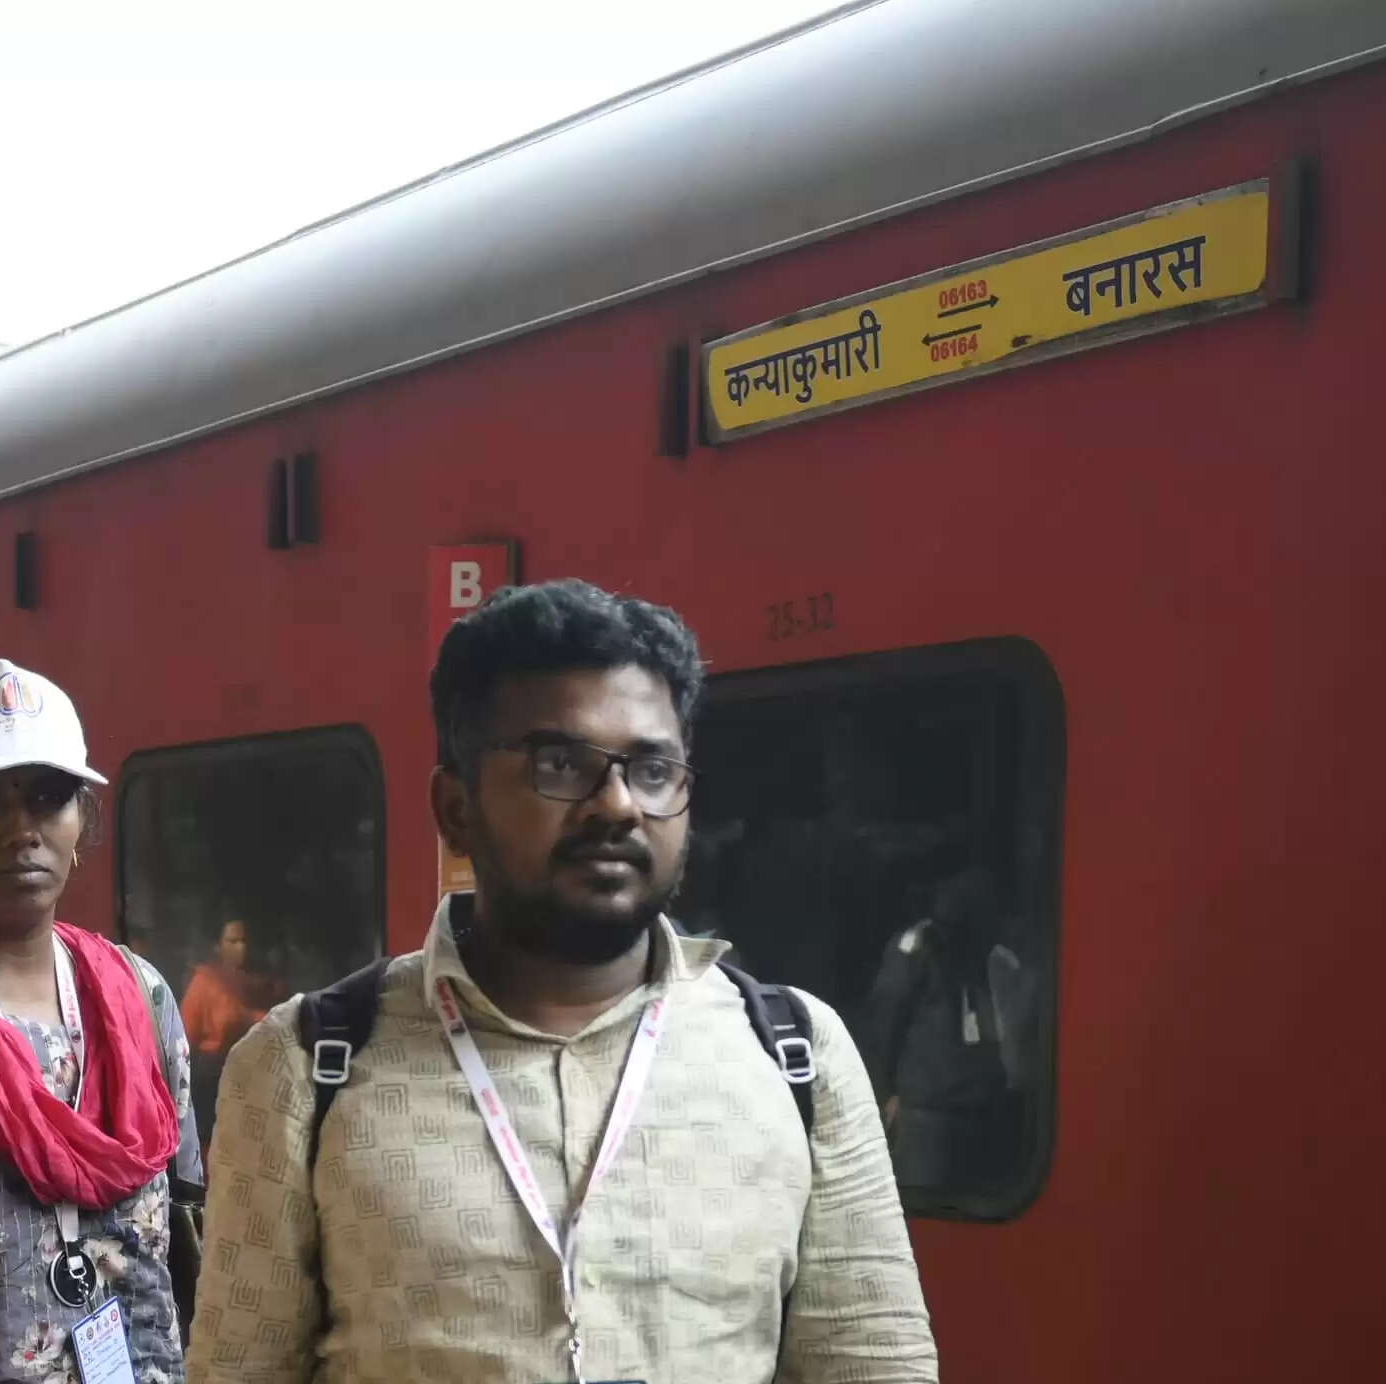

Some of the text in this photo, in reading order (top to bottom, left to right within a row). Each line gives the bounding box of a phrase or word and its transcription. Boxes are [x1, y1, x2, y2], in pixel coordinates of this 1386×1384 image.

[938, 279, 988, 309] 06163
[724, 236, 1205, 406] कन्याकुमारी बनारस
[930, 334, 979, 362] 06164
[450, 561, 482, 608] B
